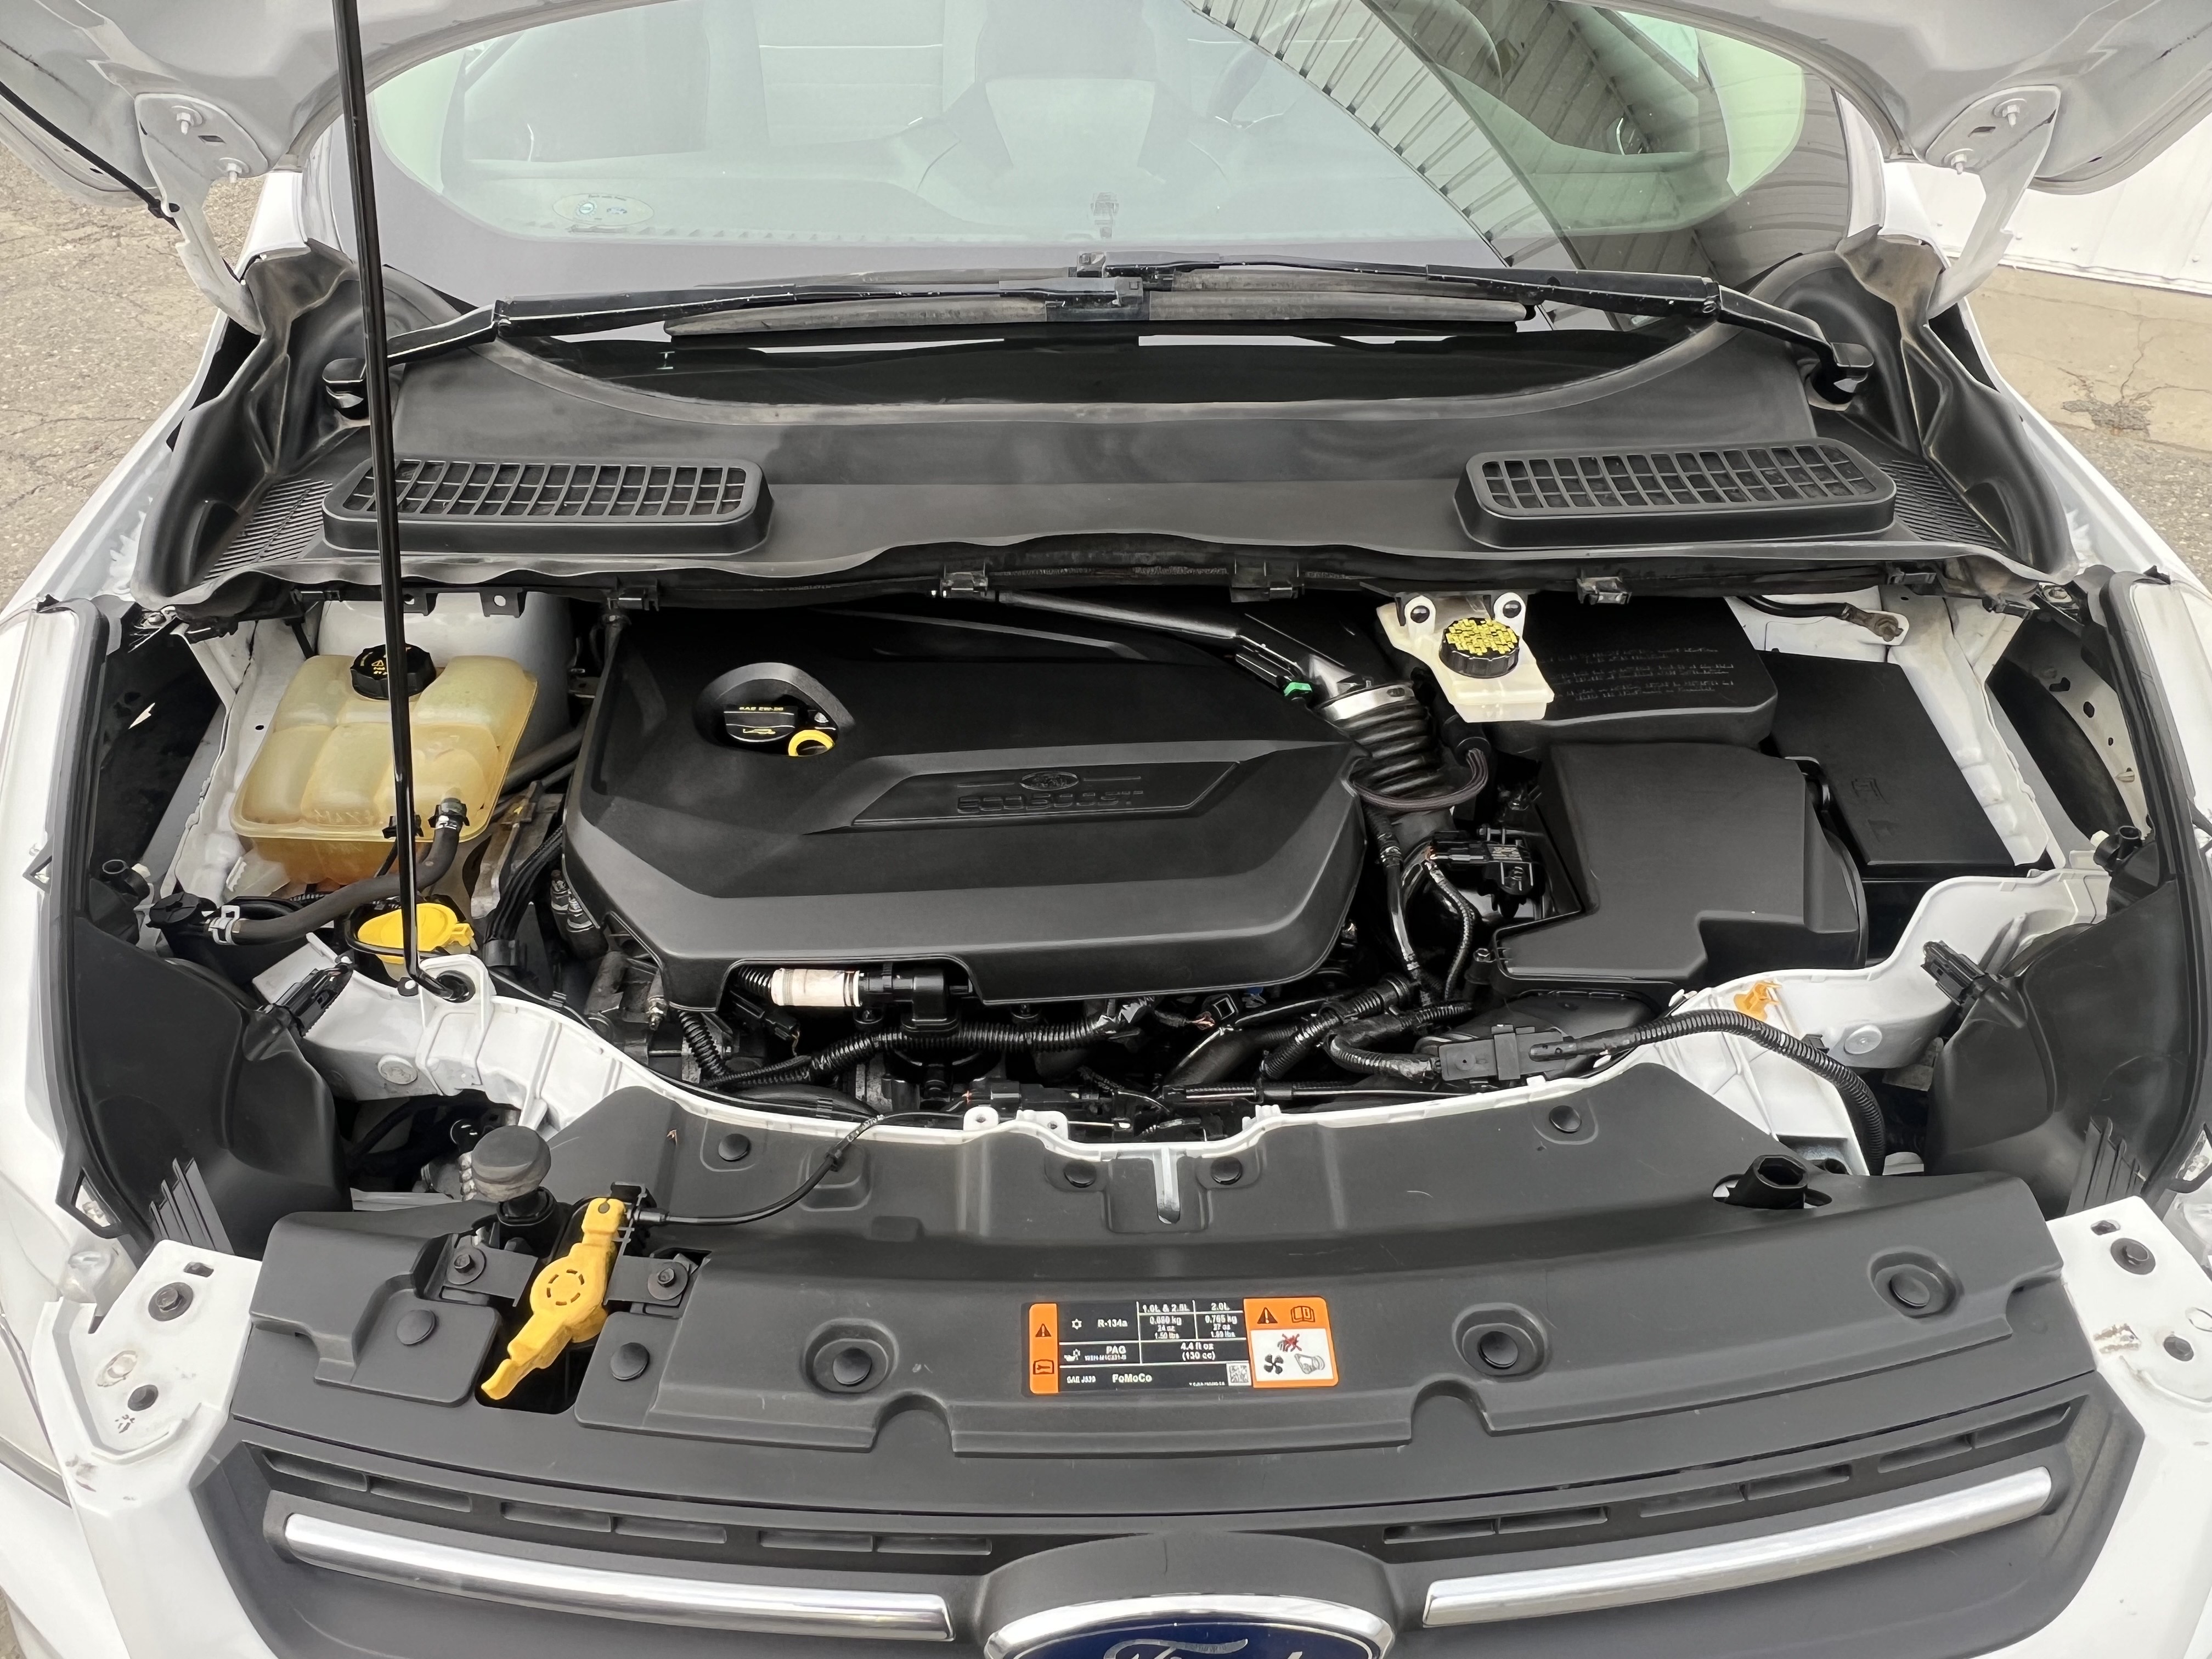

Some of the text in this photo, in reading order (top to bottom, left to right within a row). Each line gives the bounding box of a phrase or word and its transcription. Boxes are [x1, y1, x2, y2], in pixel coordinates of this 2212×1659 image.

[1097, 1318, 1128, 1328] R-134a
[1171, 1316, 1182, 1326] kg
[1227, 1314, 1238, 1324] kg
[1180, 1342, 1194, 1350] 4.4
[1195, 1341, 1202, 1350] fl
[1202, 1351, 1216, 1361] cc)
[1112, 1373, 1153, 1383] FoMoCo
